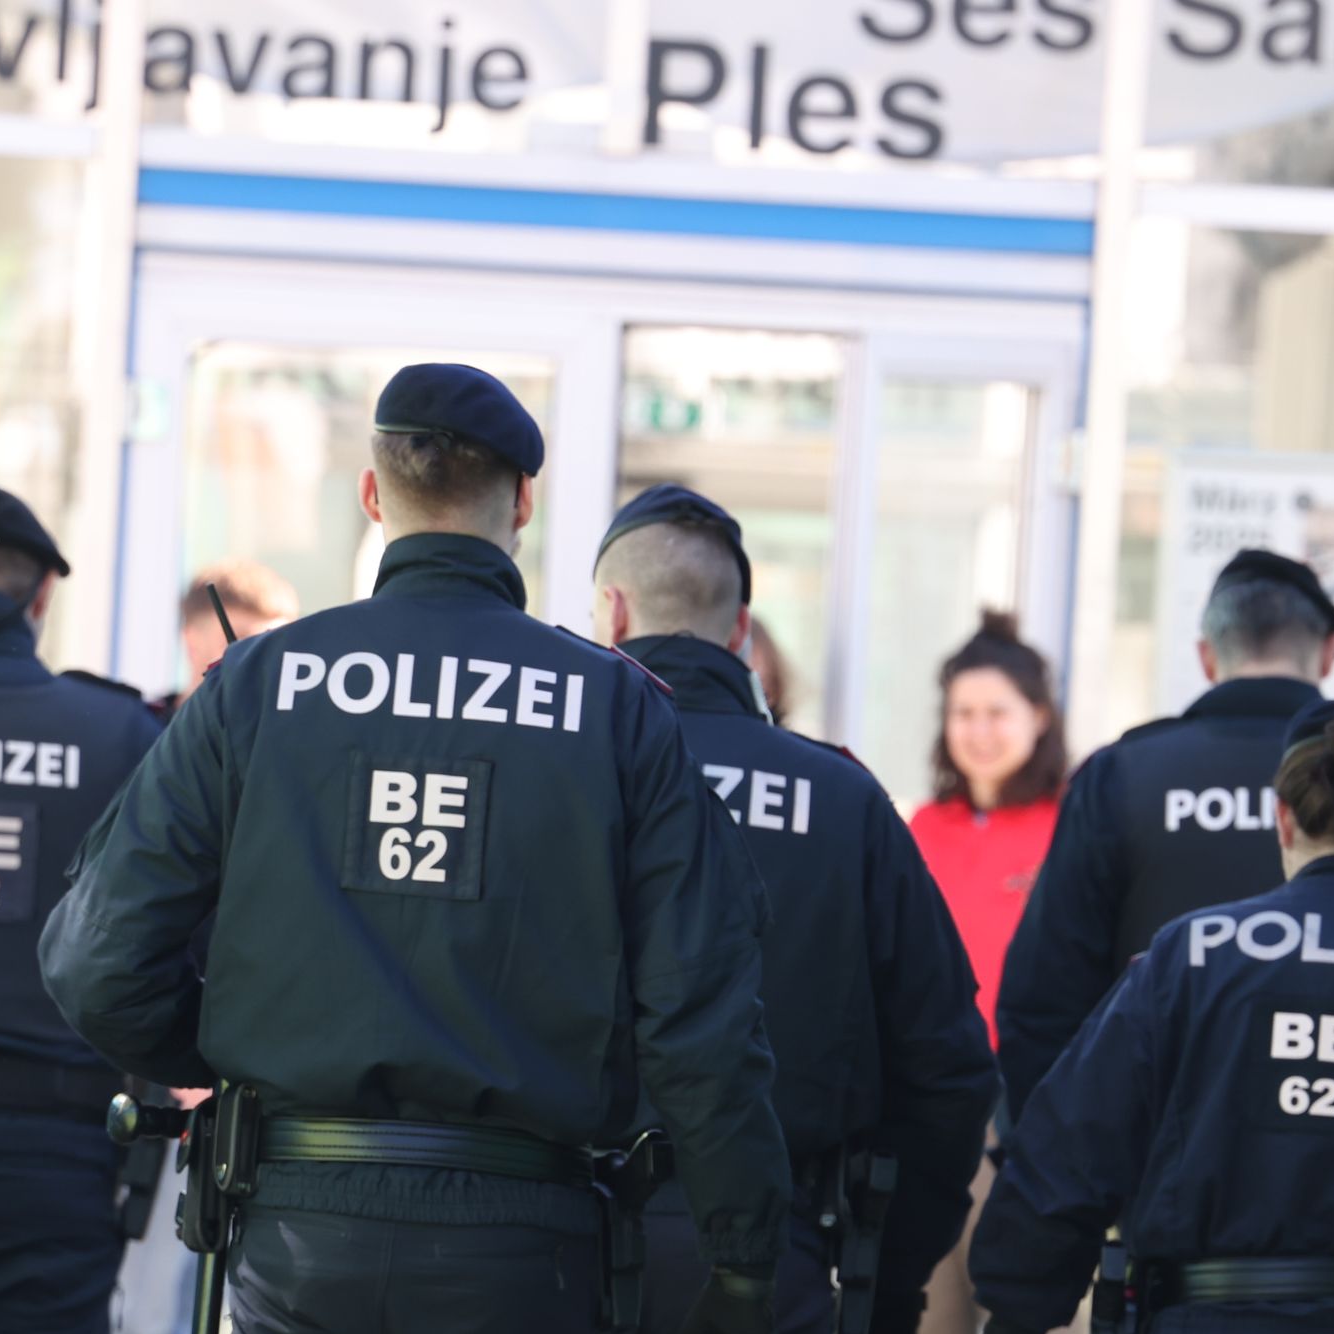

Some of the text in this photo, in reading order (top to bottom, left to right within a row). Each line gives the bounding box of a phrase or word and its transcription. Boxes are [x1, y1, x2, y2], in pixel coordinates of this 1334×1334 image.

[642, 38, 946, 159] Ples
[275, 650, 585, 733] POLIZEI
[368, 769, 469, 829] BE
[1164, 786, 1276, 832] POLI
[378, 827, 447, 883] 62
